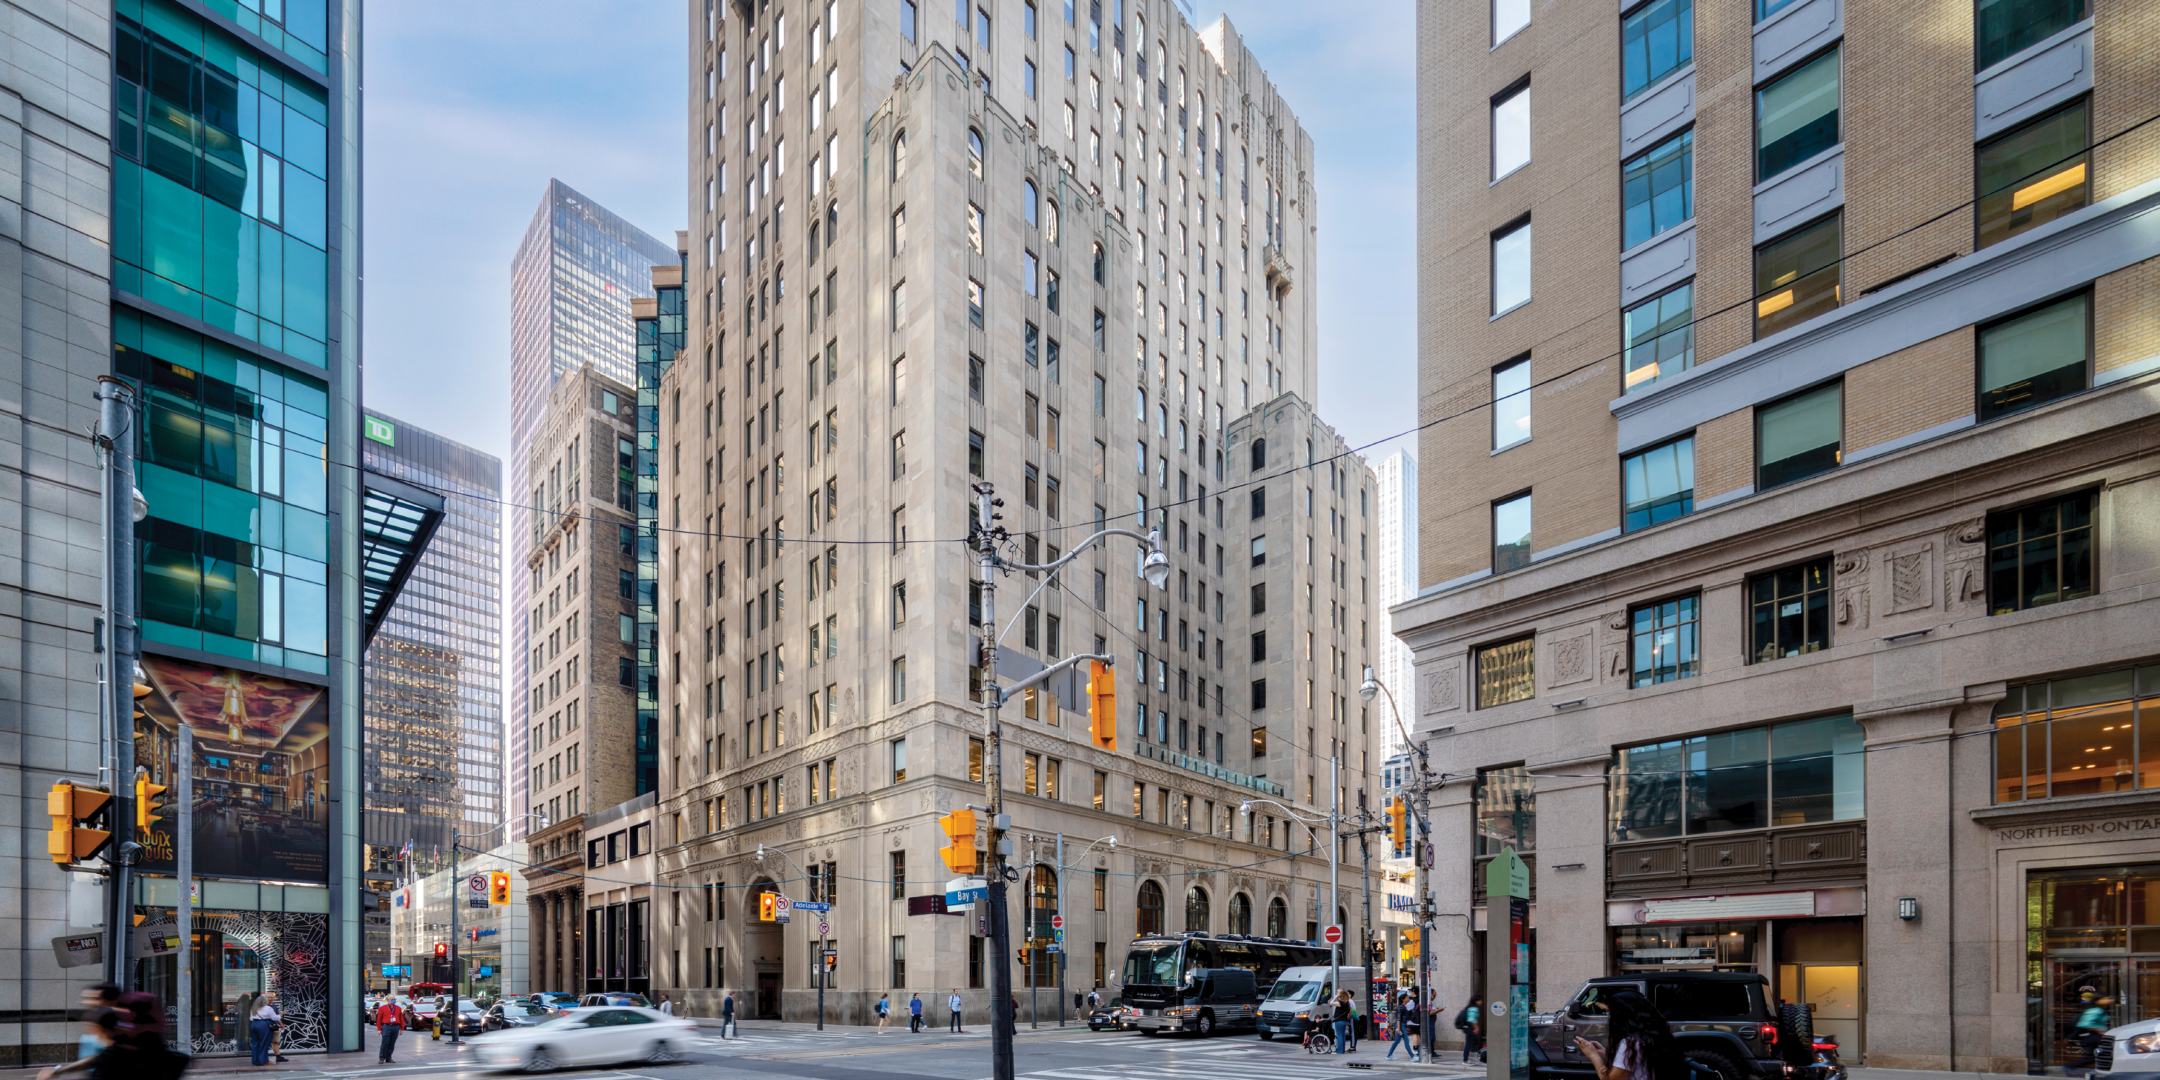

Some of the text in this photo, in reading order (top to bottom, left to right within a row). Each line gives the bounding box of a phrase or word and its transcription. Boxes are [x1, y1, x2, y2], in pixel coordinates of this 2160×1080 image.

[367, 419, 392, 440] TD
[2000, 822, 2095, 841] NORTHERN
[703, 844, 725, 857] CANADA
[744, 829, 782, 847] PERMANENT
[957, 891, 970, 902] Bay
[1388, 893, 1415, 911] BMO
[794, 902, 819, 910] Adelaide
[80, 937, 97, 949] NO!
